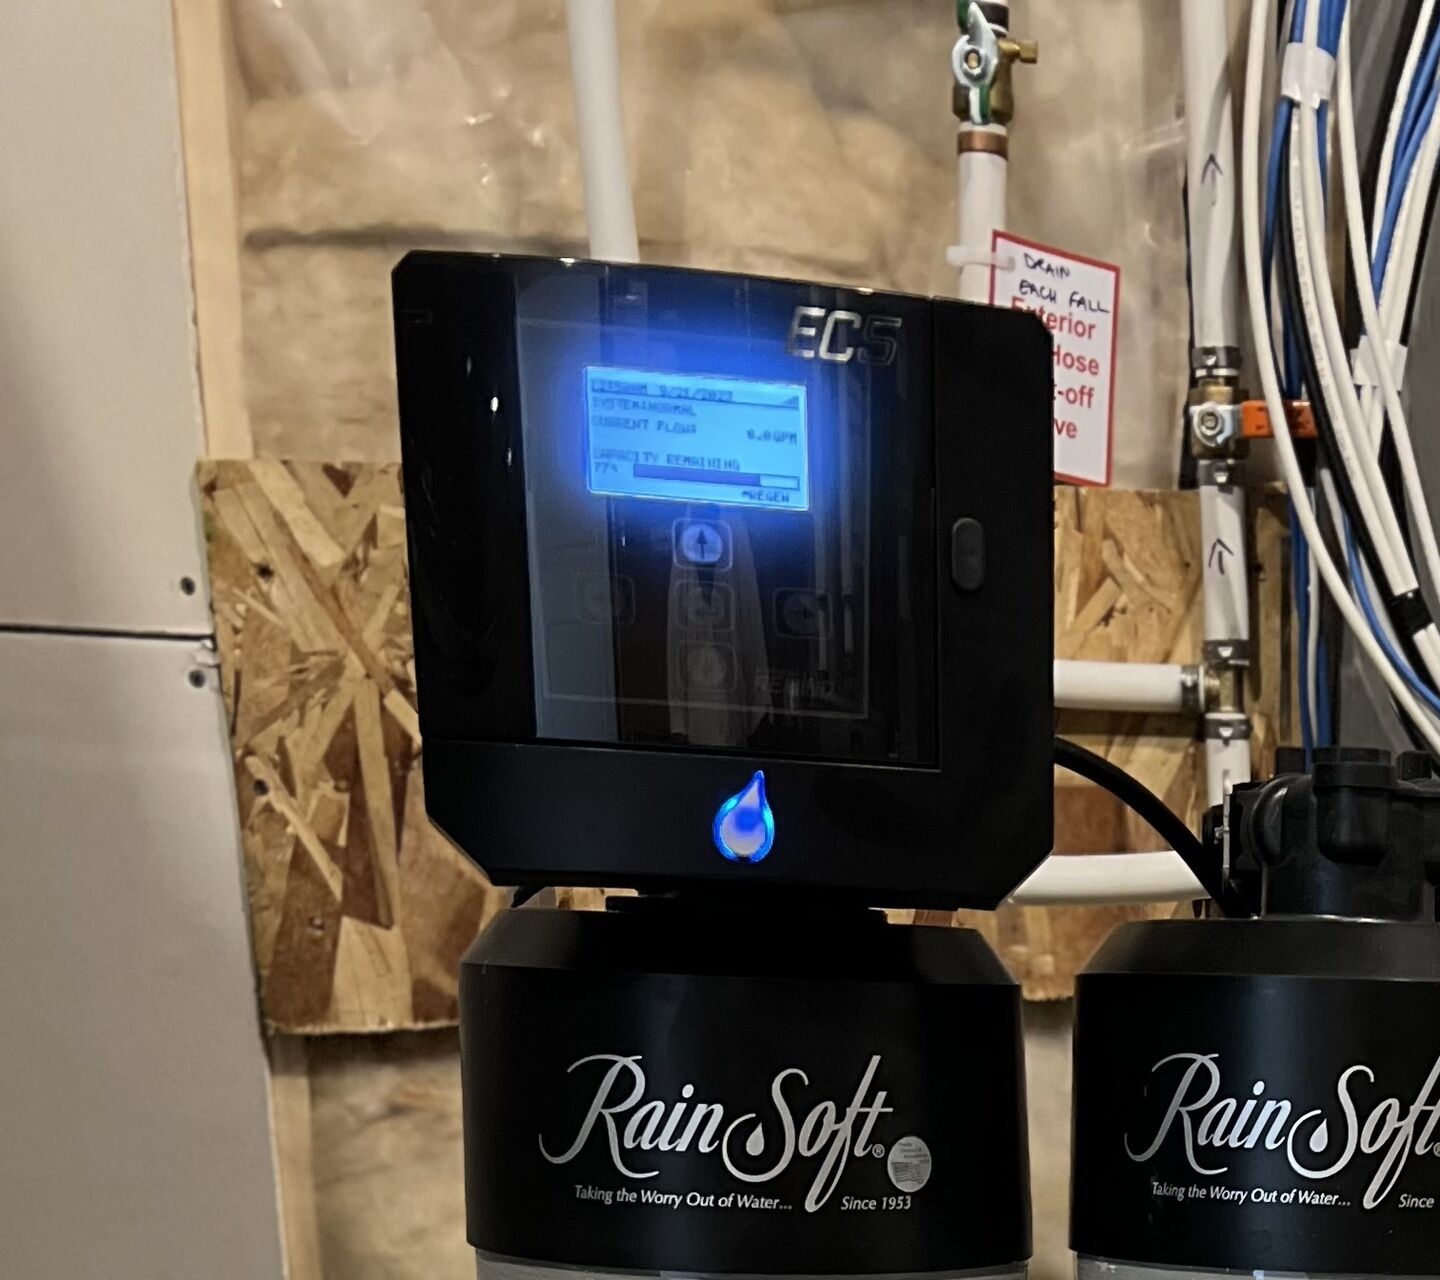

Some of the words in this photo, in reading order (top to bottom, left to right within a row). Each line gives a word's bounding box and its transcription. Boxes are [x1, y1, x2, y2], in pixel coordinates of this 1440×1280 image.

[1023, 253, 1071, 279] DRAIN
[1019, 279, 1057, 304] EACH
[1069, 291, 1110, 313] FALL
[786, 305, 902, 366] EC5
[666, 455, 740, 472] REMAINING
[574, 1185, 613, 1205] Taking
[616, 1187, 638, 1203] the
[640, 1189, 683, 1208] Worry
[686, 1192, 715, 1208] Out
[718, 1192, 735, 1208] of
[840, 1195, 878, 1211] Since
[881, 1195, 912, 1211] 1953
[1151, 1181, 1186, 1201] Taking
[1188, 1184, 1207, 1199] the
[1210, 1186, 1249, 1206] Worry
[1250, 1188, 1278, 1203] Out
[1280, 1188, 1297, 1204] of
[1398, 1193, 1435, 1210] Since
